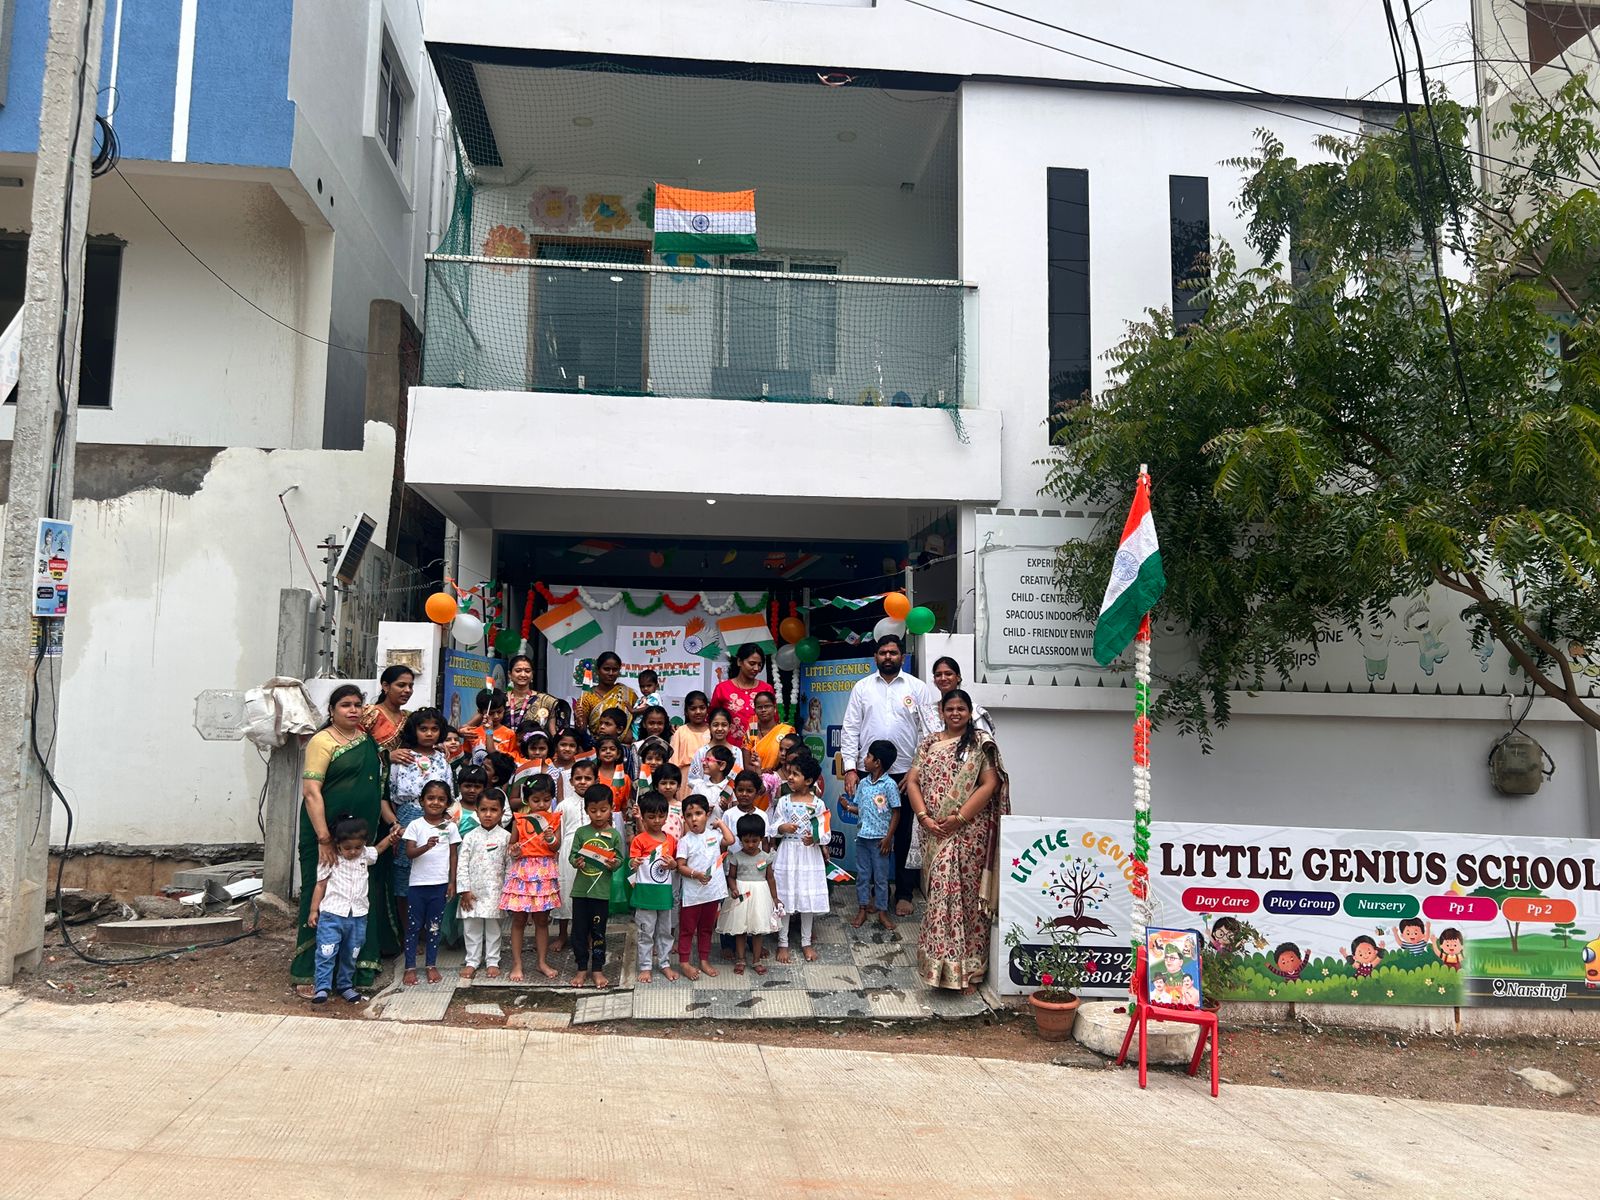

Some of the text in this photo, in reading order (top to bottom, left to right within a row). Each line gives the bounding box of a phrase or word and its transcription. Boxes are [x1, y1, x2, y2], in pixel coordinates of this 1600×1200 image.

[1027, 558, 1056, 568] EXPERI
[1020, 576, 1056, 585] CREATIVE
[1011, 593, 1034, 602] CHILD
[1006, 610, 1043, 620] SPACIOUS
[633, 630, 681, 646] HAPPY
[1003, 627, 1026, 637] CHILD
[1032, 628, 1068, 638] FRIENDLY
[1070, 629, 1094, 639] ENVIR
[1310, 630, 1344, 643] ONE
[1008, 645, 1094, 656] EACH CLASSROOM WIT
[449, 656, 490, 673] LITTLE GENIUS
[805, 663, 870, 676] LITTLE GENIUS
[454, 675, 484, 688] PRESCHOO
[811, 681, 856, 692] PRESCHOO
[1011, 829, 1136, 893] LITTLE GENIU
[1160, 842, 1600, 891] LITTLE GENIUS SCHOOL
[1195, 895, 1250, 909] Day Care
[1269, 897, 1336, 912] Play Group
[1358, 899, 1406, 912] Nursery
[1449, 902, 1474, 914] Pp 1
[1527, 903, 1552, 915] Pp 2
[1506, 982, 1567, 1001] Narsingi
